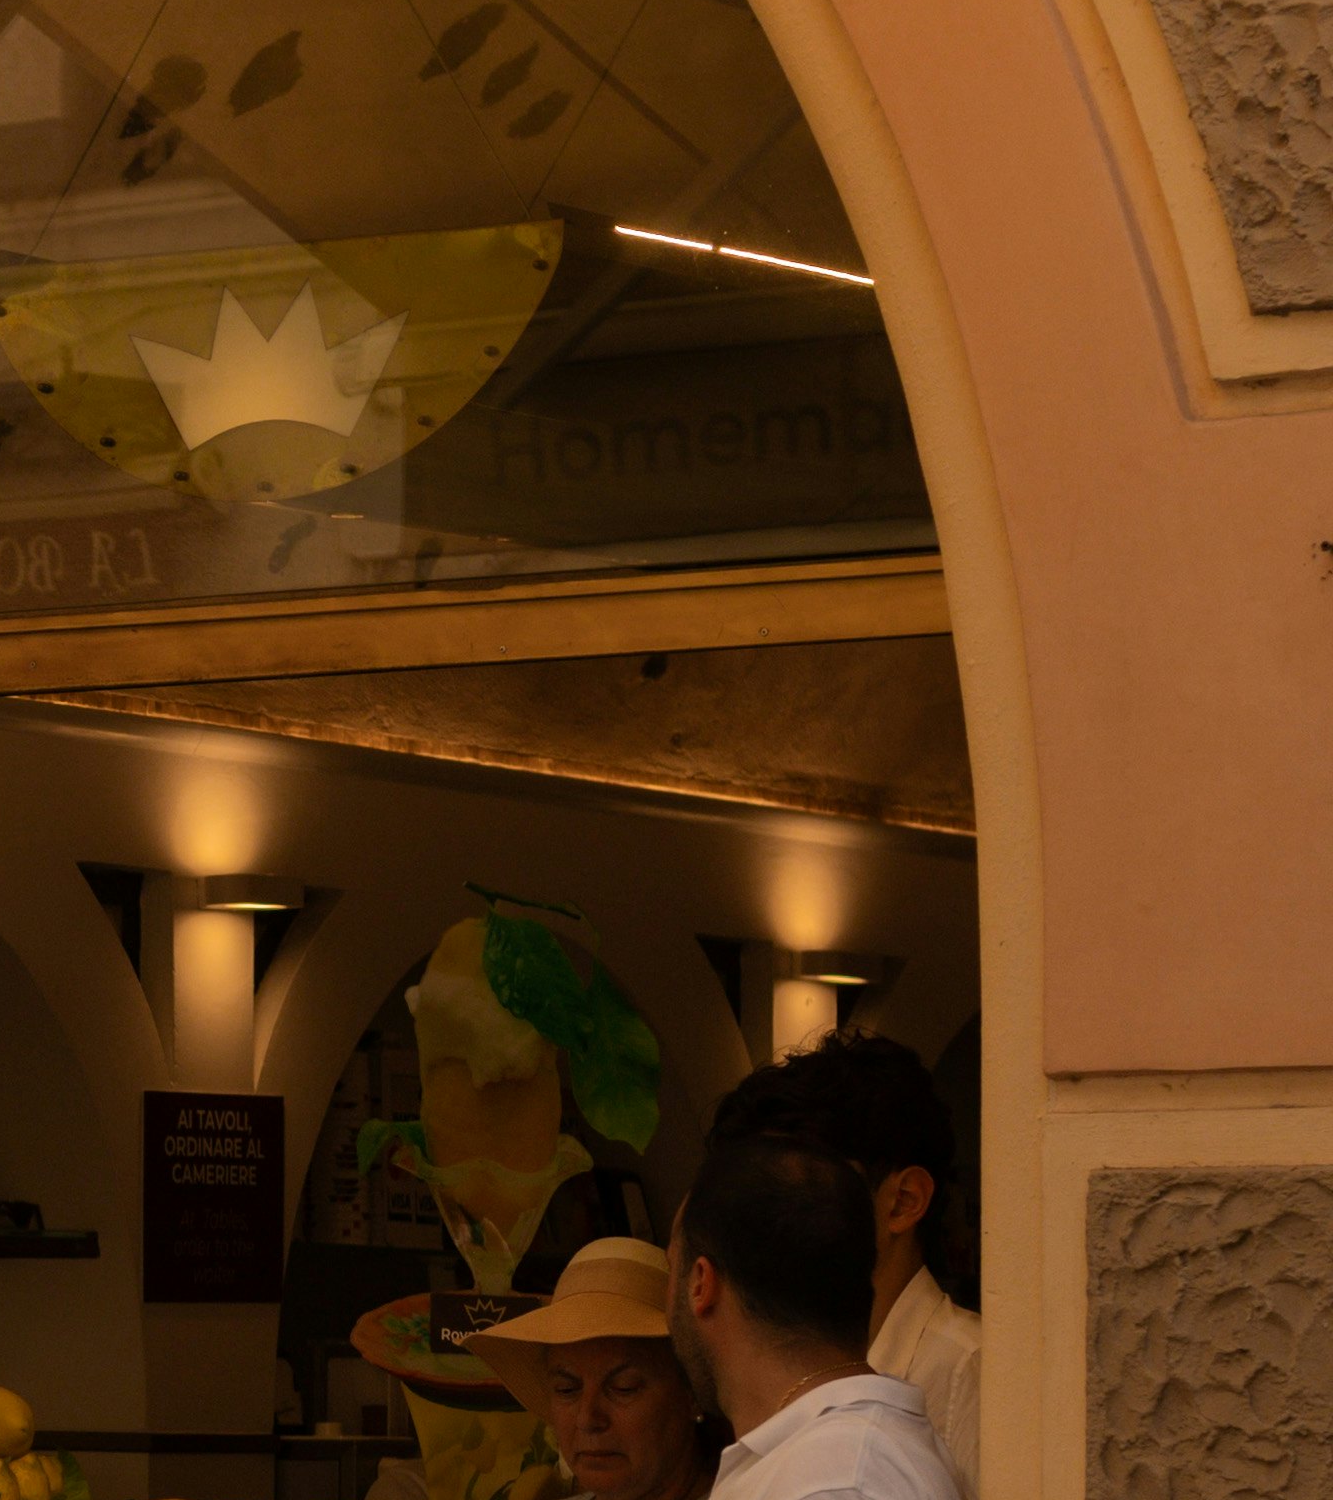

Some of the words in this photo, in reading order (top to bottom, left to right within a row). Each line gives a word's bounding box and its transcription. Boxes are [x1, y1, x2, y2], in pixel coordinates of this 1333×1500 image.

[176, 1109, 193, 1131] AI
[197, 1109, 253, 1135] TAVOLI,
[164, 1135, 242, 1158] ORDINARE
[245, 1137, 266, 1159] AL
[171, 1163, 258, 1186] CAMERIERE
[441, 1327, 480, 1341] Roy
